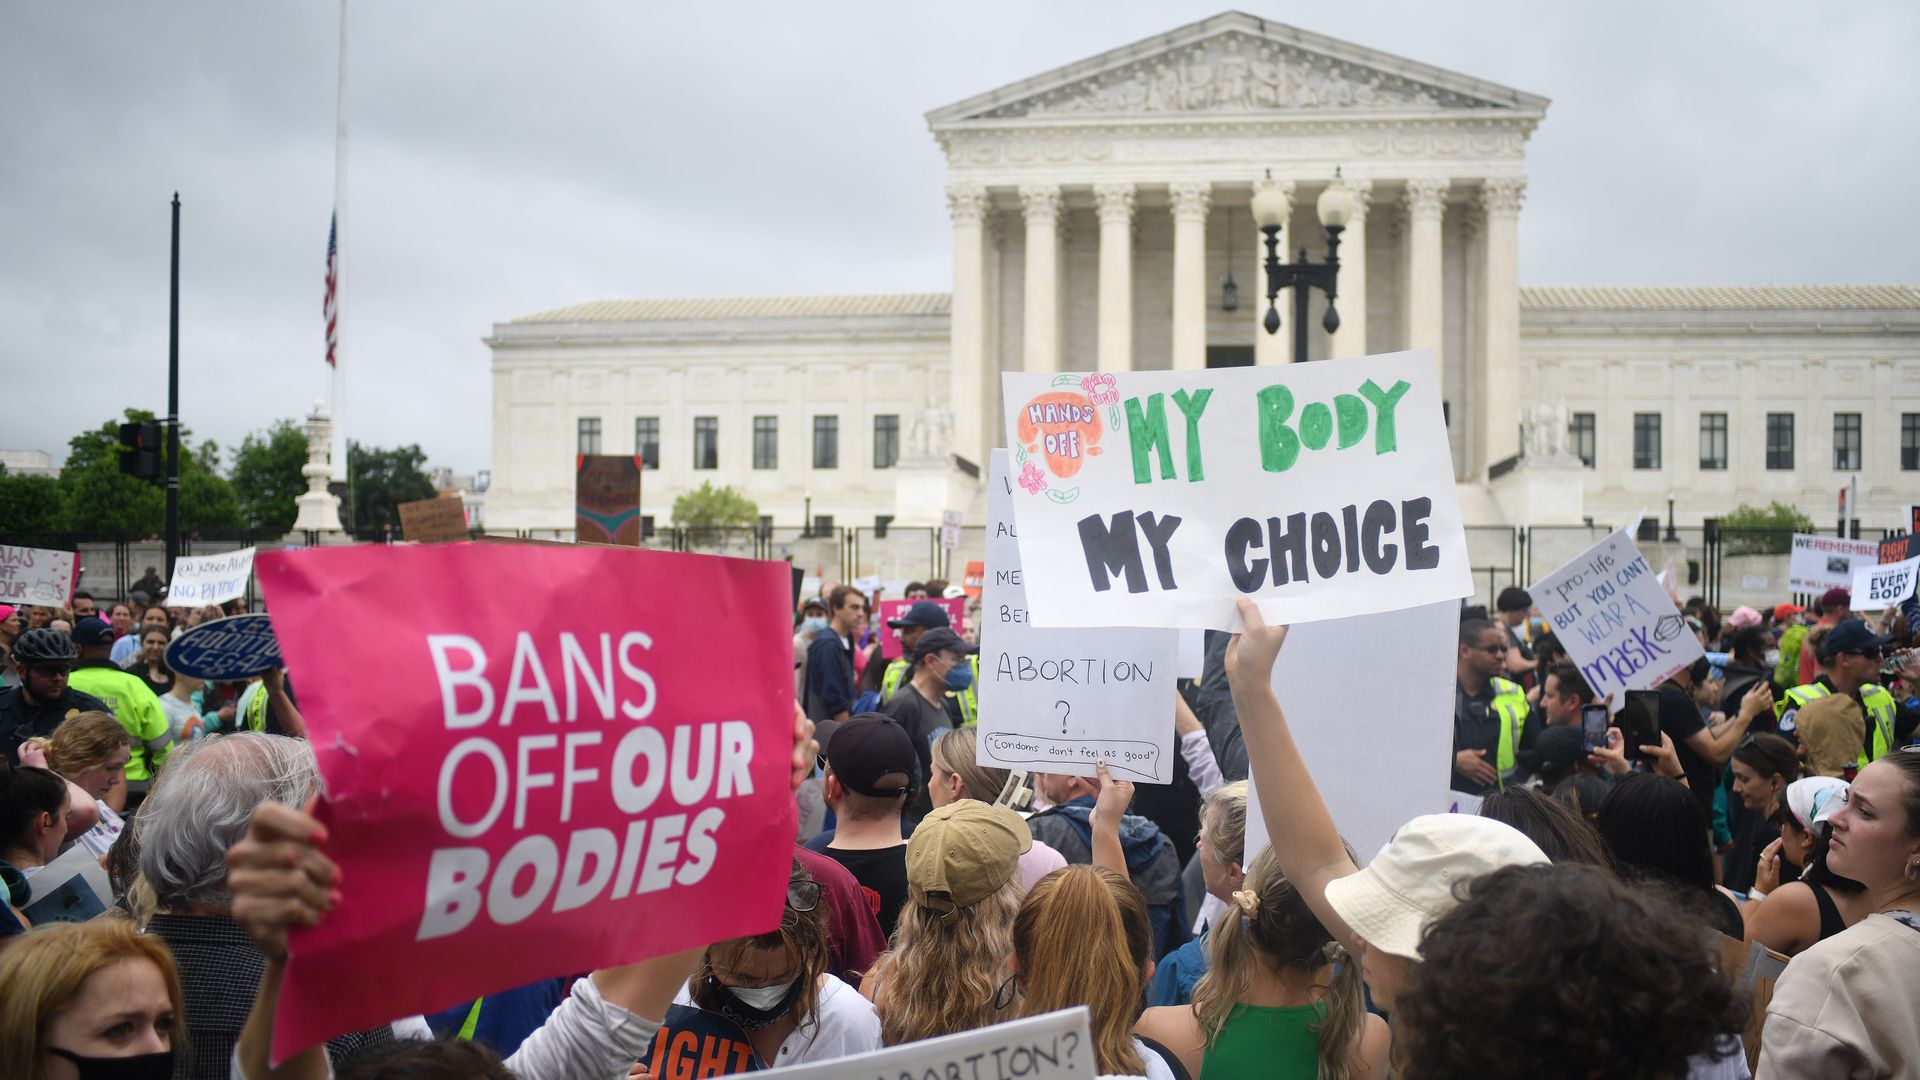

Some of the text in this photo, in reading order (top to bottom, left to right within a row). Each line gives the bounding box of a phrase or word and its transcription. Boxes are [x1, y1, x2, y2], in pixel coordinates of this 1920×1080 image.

[1028, 402, 1095, 425] HANDS
[1044, 429, 1080, 459] OFF
[1124, 378, 1412, 485] MY BODY
[997, 522, 1017, 538] AL
[1077, 496, 1440, 593] MY CHOICE
[0, 546, 36, 568] AWS
[1814, 539, 1879, 557] REMEMBE
[174, 584, 196, 598] NO
[997, 570, 1022, 586] ME
[1871, 571, 1910, 590] EVERY
[1554, 602, 1583, 630] BUT
[1586, 580, 1616, 605] YOU
[1577, 592, 1651, 646] WEAR A
[222, 616, 275, 637] KEE
[180, 629, 281, 658] ABORTIO
[427, 631, 657, 730] BANS
[996, 652, 1153, 684] ABORTION
[1055, 700, 1071, 735] ?
[1049, 746, 1073, 757] don't
[1080, 746, 1099, 758] feel
[1104, 750, 1117, 758] as
[437, 720, 754, 839] OFF OUR
[415, 806, 726, 942] BODIES
[649, 1026, 753, 1080] IGHT
[878, 1031, 1080, 1080] RTION?
